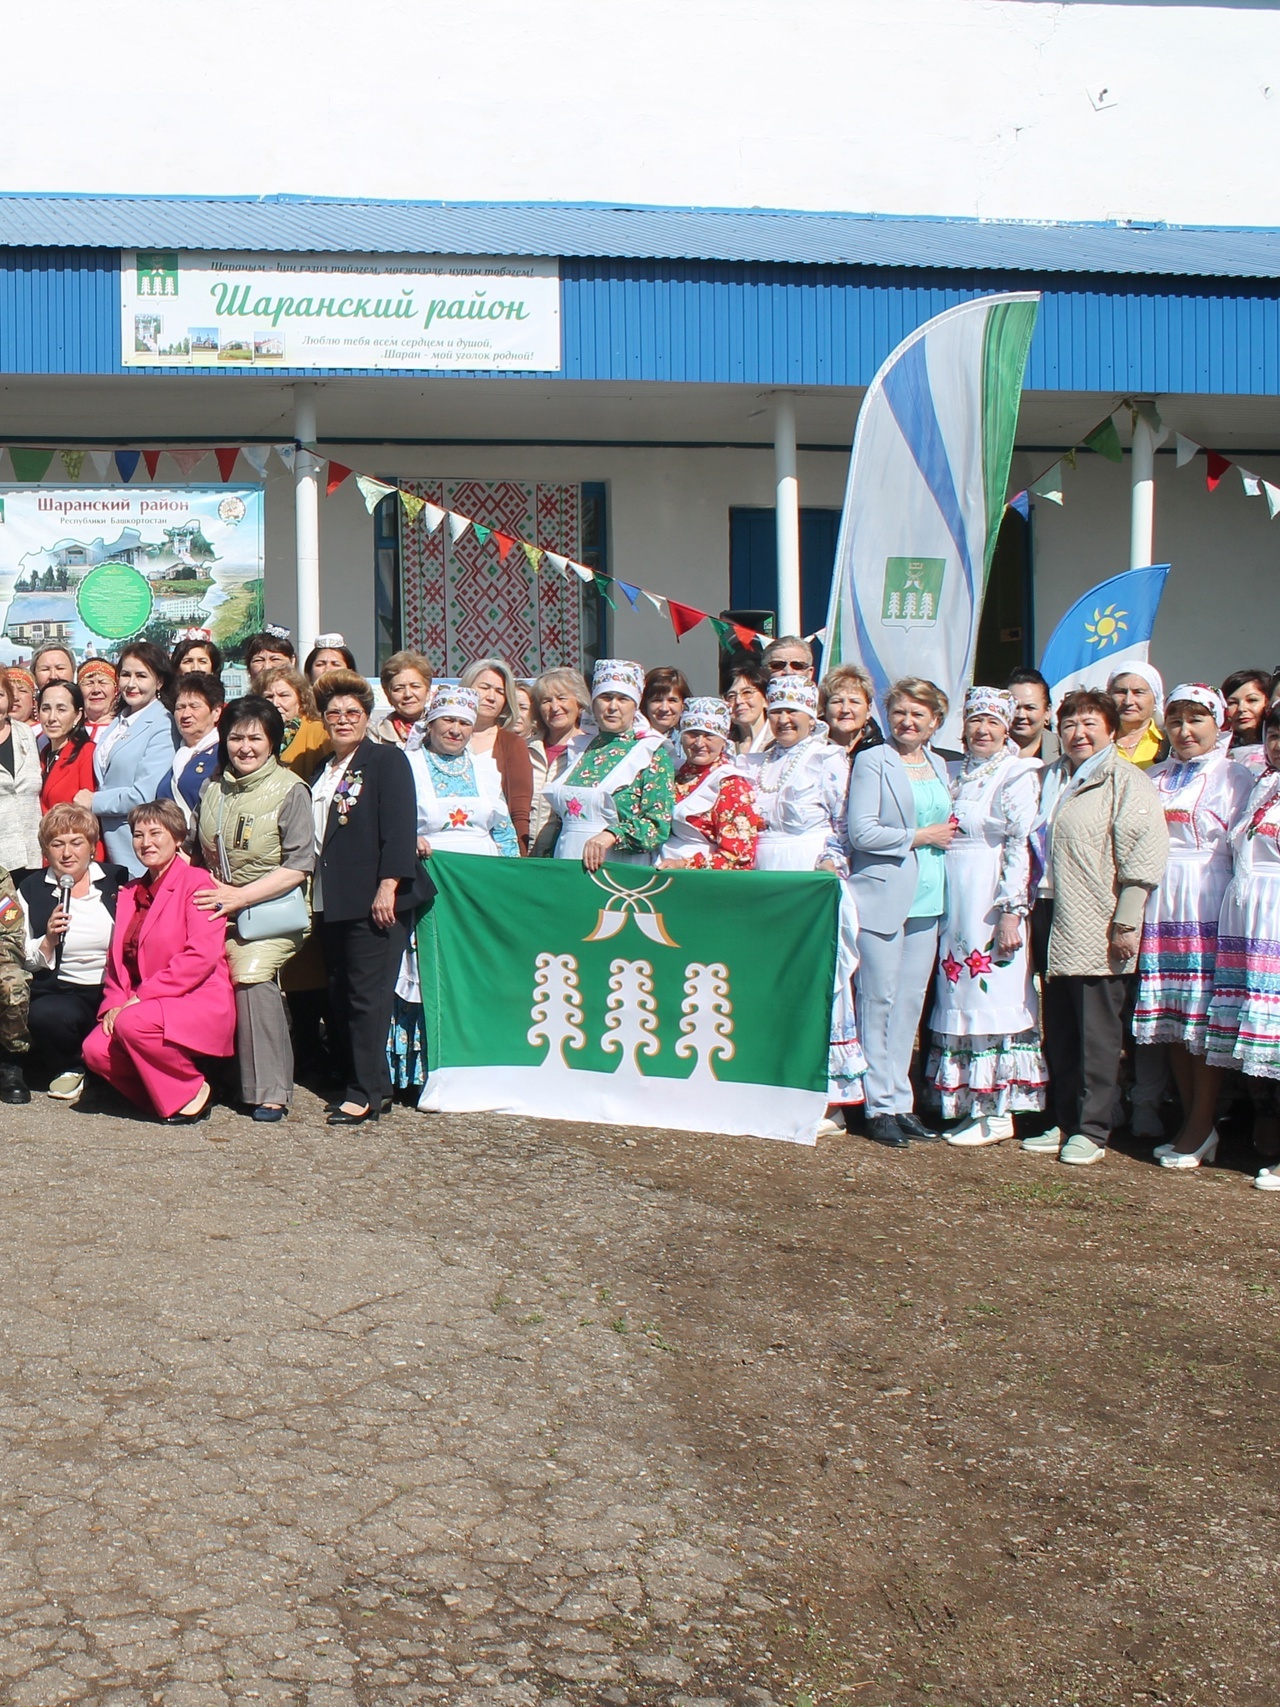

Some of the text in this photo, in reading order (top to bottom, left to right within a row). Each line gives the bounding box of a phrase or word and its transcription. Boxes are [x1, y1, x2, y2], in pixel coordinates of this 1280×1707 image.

[210, 282, 531, 330] Шаранский район
[302, 336, 493, 350] Люблю тебя всем сердцем и душой,
[431, 349, 453, 361] мой
[455, 351, 490, 362] уголок
[493, 350, 534, 363] родной!
[38, 498, 189, 516] Шаранский район
[60, 517, 167, 525] Республики Башкортостан
